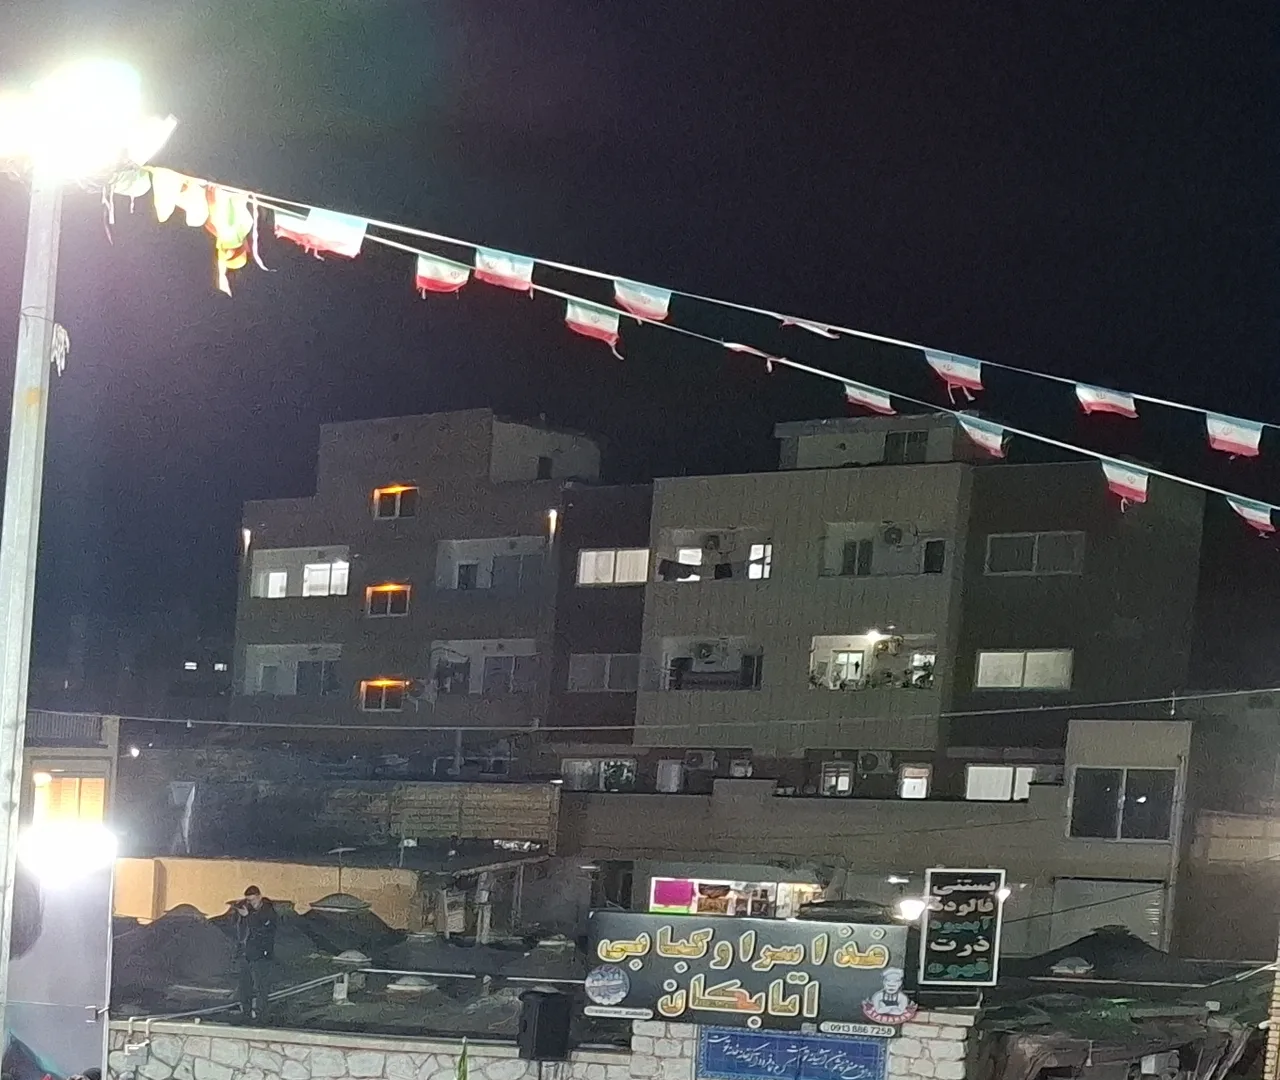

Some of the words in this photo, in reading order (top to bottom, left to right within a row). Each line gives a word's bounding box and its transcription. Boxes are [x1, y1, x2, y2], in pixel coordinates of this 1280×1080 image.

[933, 878, 996, 896] بستنی
[925, 897, 994, 916] فالوده
[596, 925, 714, 973] کبابی
[710, 940, 733, 970] و
[739, 929, 804, 971] سرا
[811, 924, 890, 969] غذا
[929, 935, 990, 957] ذرت
[927, 957, 990, 980] قهوه
[657, 972, 820, 1028] اتابکان
[830, 1023, 851, 1033] 0913
[870, 1026, 893, 1036] 7258
